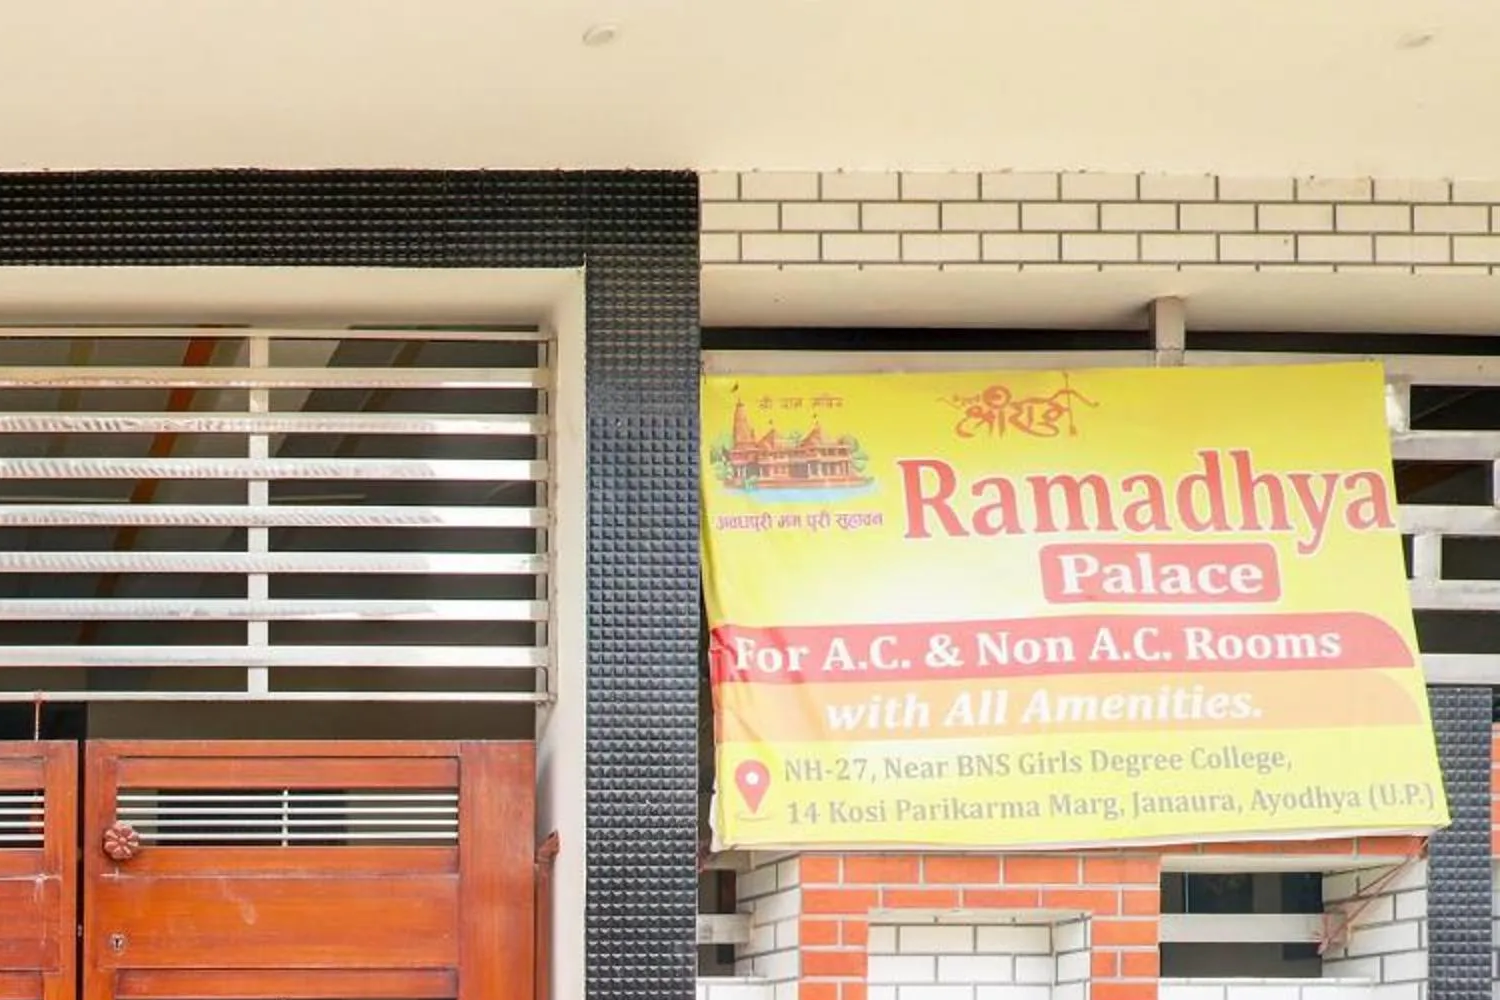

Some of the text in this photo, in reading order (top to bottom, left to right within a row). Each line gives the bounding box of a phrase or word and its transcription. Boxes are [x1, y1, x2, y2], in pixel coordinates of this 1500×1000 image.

[897, 449, 1396, 554] Ramadhya
[1057, 551, 1264, 595] Palace
[733, 627, 1343, 673] For A.C. & Non A.C. Rooms
[826, 684, 1263, 731] with All Amenities.
[784, 746, 1293, 784] NH-27, Near BNS Girls Degree College,
[787, 783, 1435, 825] 14 Kosi Parikarma Marg, Janaura, Ayodhya (U.P.)
